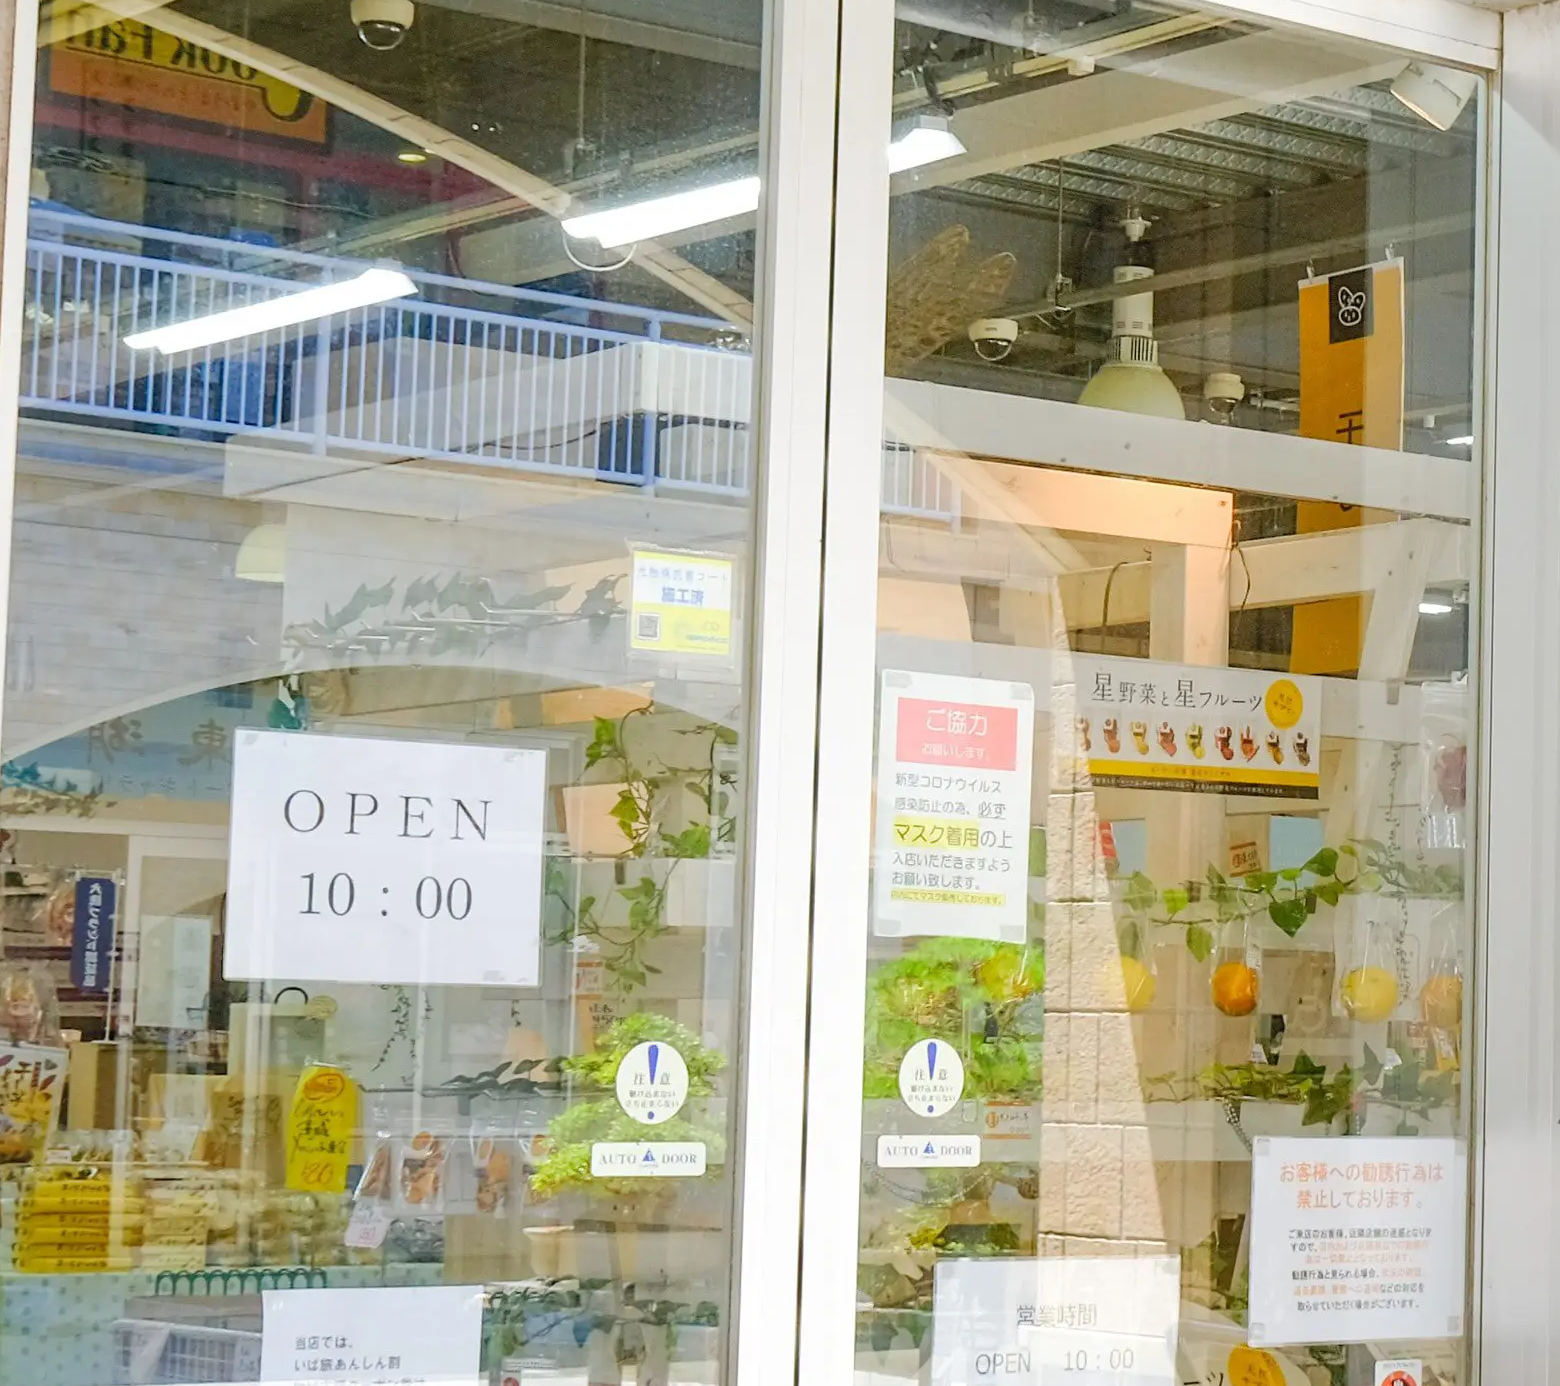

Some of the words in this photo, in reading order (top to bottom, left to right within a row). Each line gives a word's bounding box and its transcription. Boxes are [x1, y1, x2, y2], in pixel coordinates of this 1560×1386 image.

[1092, 671, 1263, 712] 星野菜と星フルーツ
[925, 707, 988, 736] ご協力
[895, 772, 1002, 794] 新型コロナウイルス
[282, 788, 493, 842] OPEN
[893, 822, 1014, 850] マスク着用の上
[600, 1154, 637, 1165] AUTO
[661, 1153, 698, 1164] DOOR
[940, 1145, 973, 1156] DOOR
[1279, 1162, 1444, 1184] お客様への勧誘行為は
[1296, 1188, 1423, 1210] 禁止しております。
[1016, 1303, 1098, 1328] 営業時間
[974, 1351, 1032, 1376] OPEN
